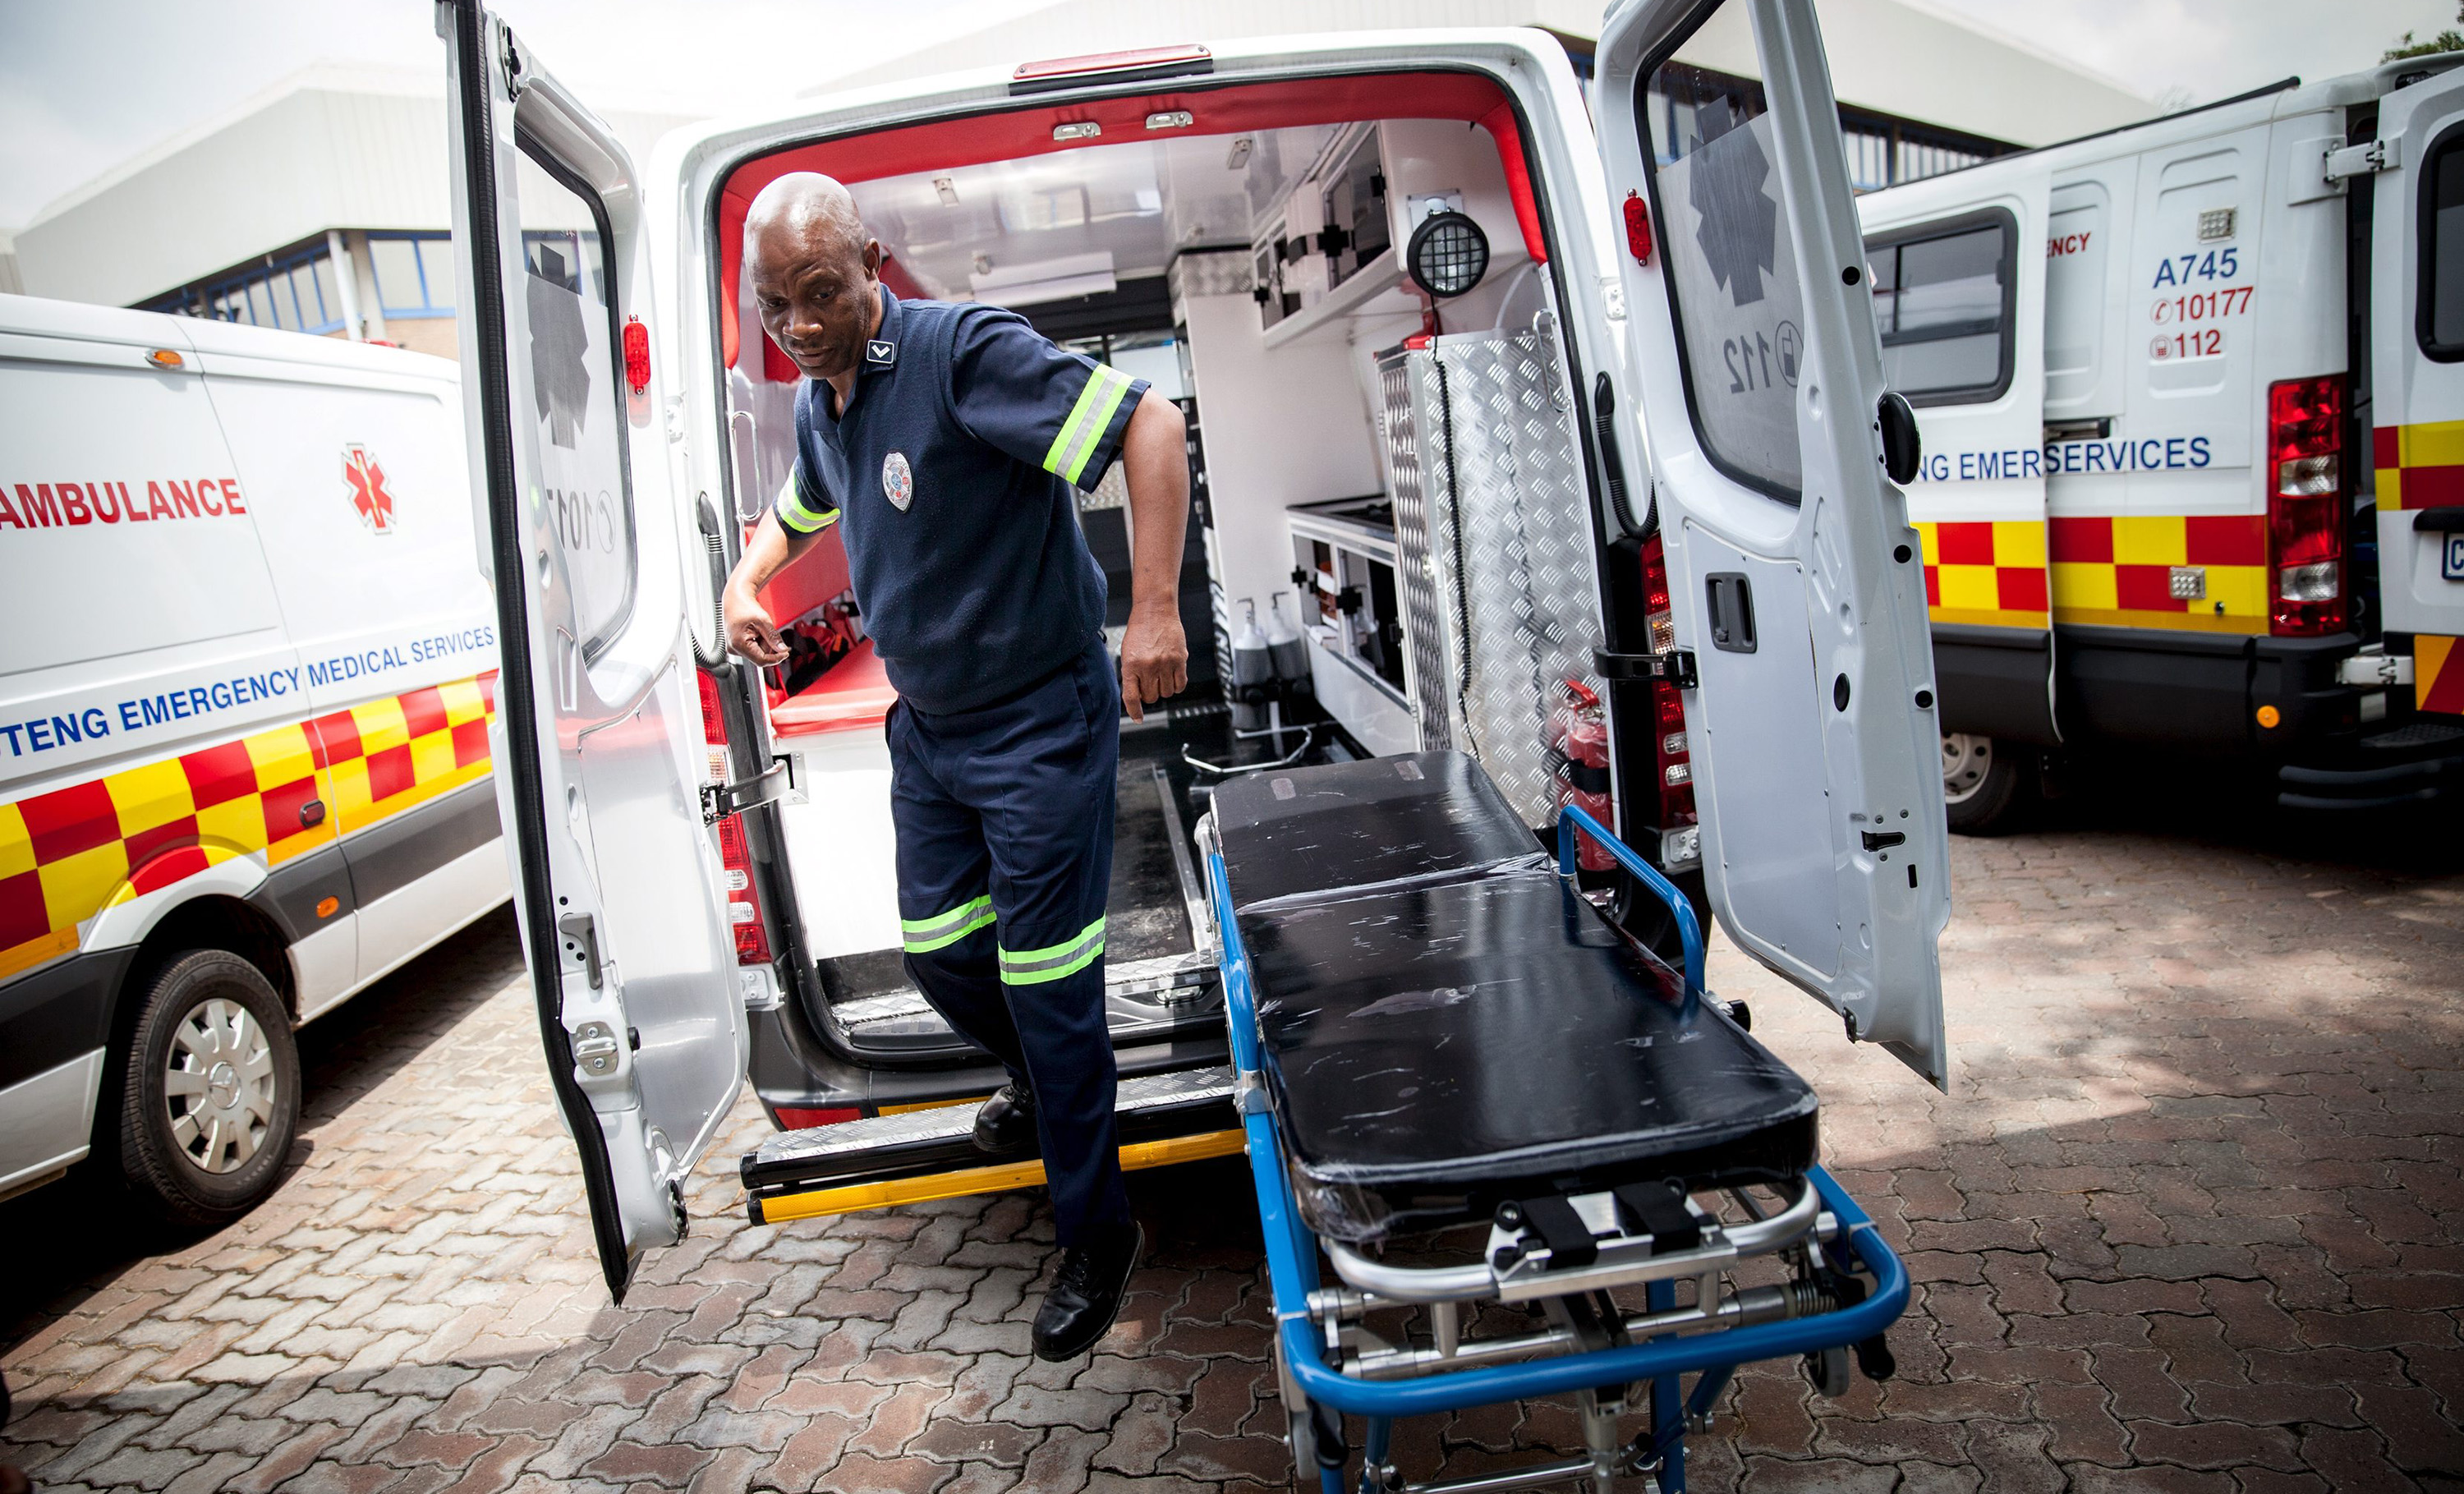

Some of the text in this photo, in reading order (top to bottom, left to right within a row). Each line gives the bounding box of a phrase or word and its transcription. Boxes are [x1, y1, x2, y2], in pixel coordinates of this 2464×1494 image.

[2047, 231, 2091, 259] NCY
[2152, 248, 2237, 289] A745
[2175, 286, 2254, 322] 10177
[2175, 329, 2221, 358] 112
[1960, 450, 2041, 480] EMER
[2043, 437, 2210, 474] SERVICES
[0, 479, 246, 530] AMBULANCE
[118, 668, 299, 731] EMERGENCY
[308, 646, 407, 687] MEDICAL
[411, 627, 494, 663] SERVICES
